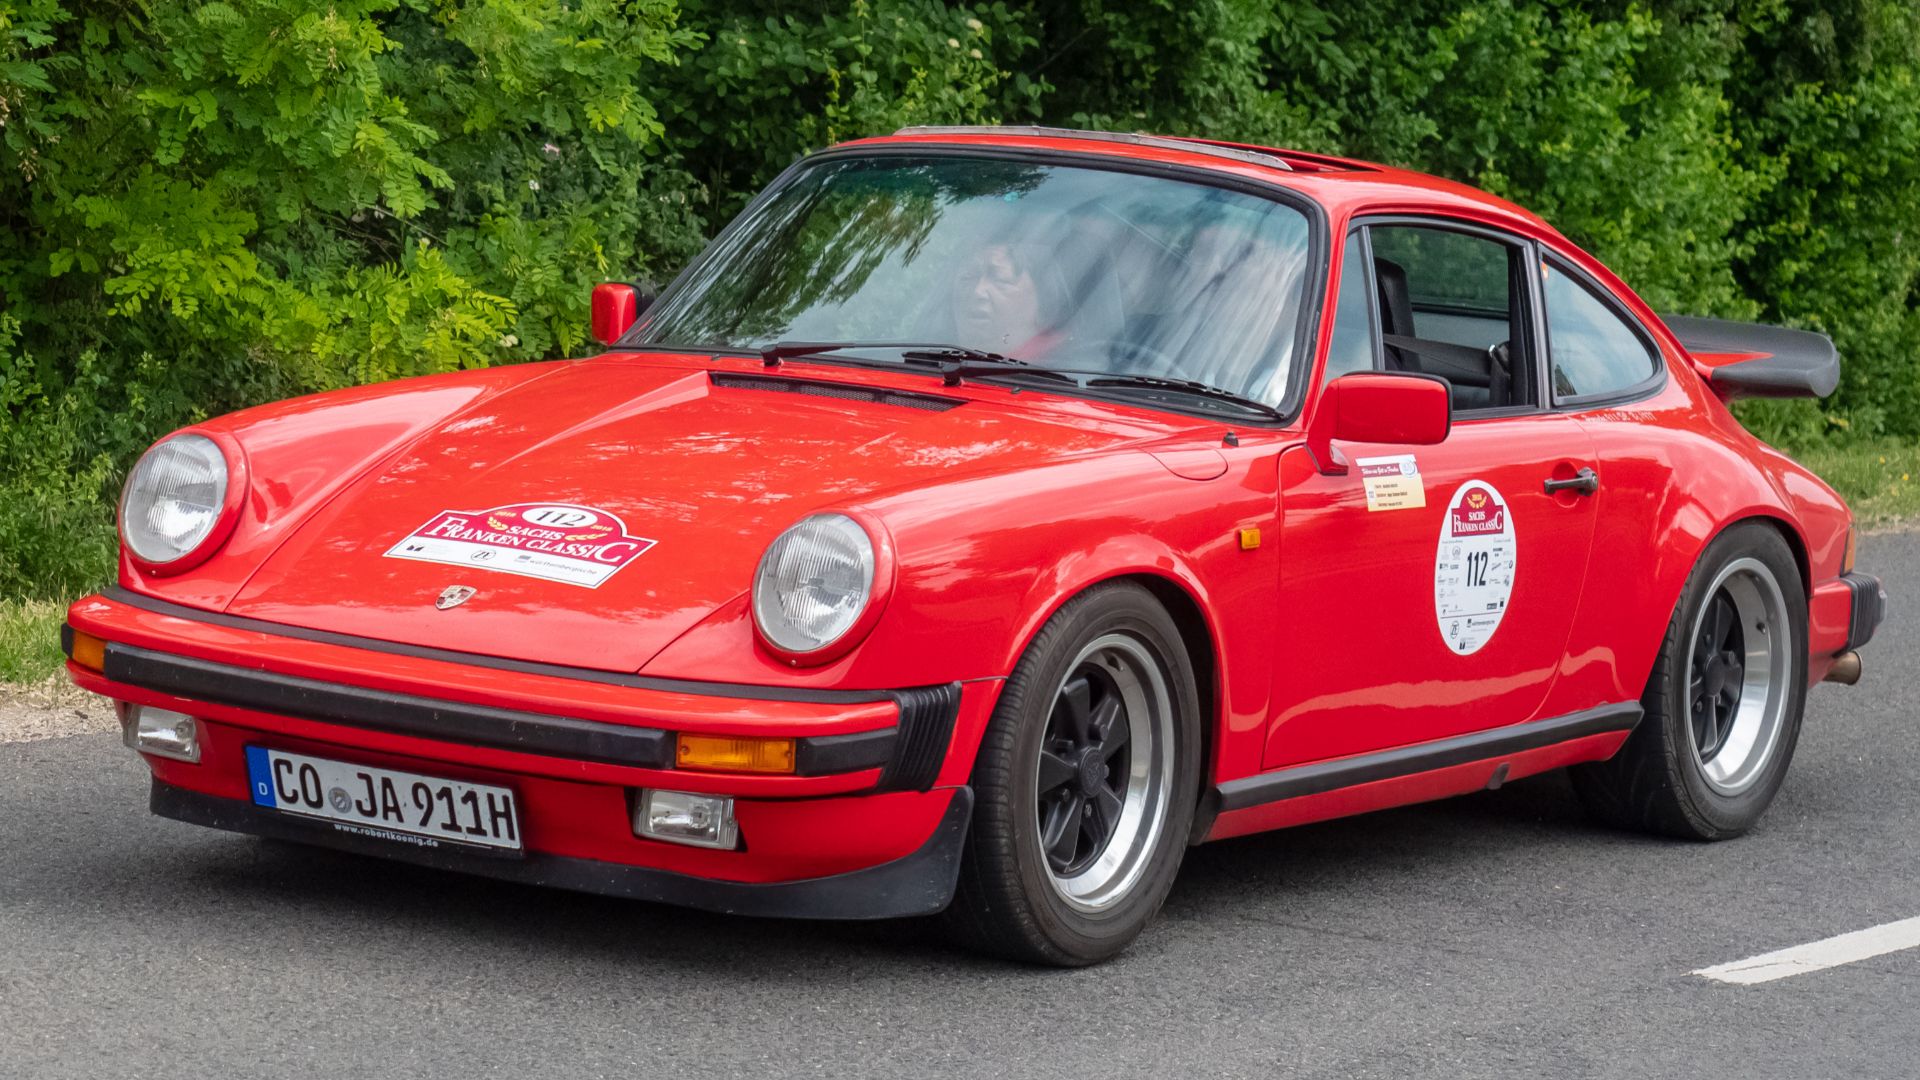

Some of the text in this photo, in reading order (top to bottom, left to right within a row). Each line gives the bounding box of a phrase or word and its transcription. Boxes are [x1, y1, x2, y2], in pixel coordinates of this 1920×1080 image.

[536, 510, 587, 527] 112
[1453, 511, 1503, 533] FRANKEN CLASSIC
[1467, 511, 1486, 521] SACHS
[424, 516, 638, 563] FRANKEN CLASSIC
[506, 525, 566, 541] SACHS
[1466, 551, 1489, 588] 112
[258, 782, 268, 796] D
[273, 758, 516, 841] CO JA 911H
[334, 823, 439, 848] www.robertkoenig.de
